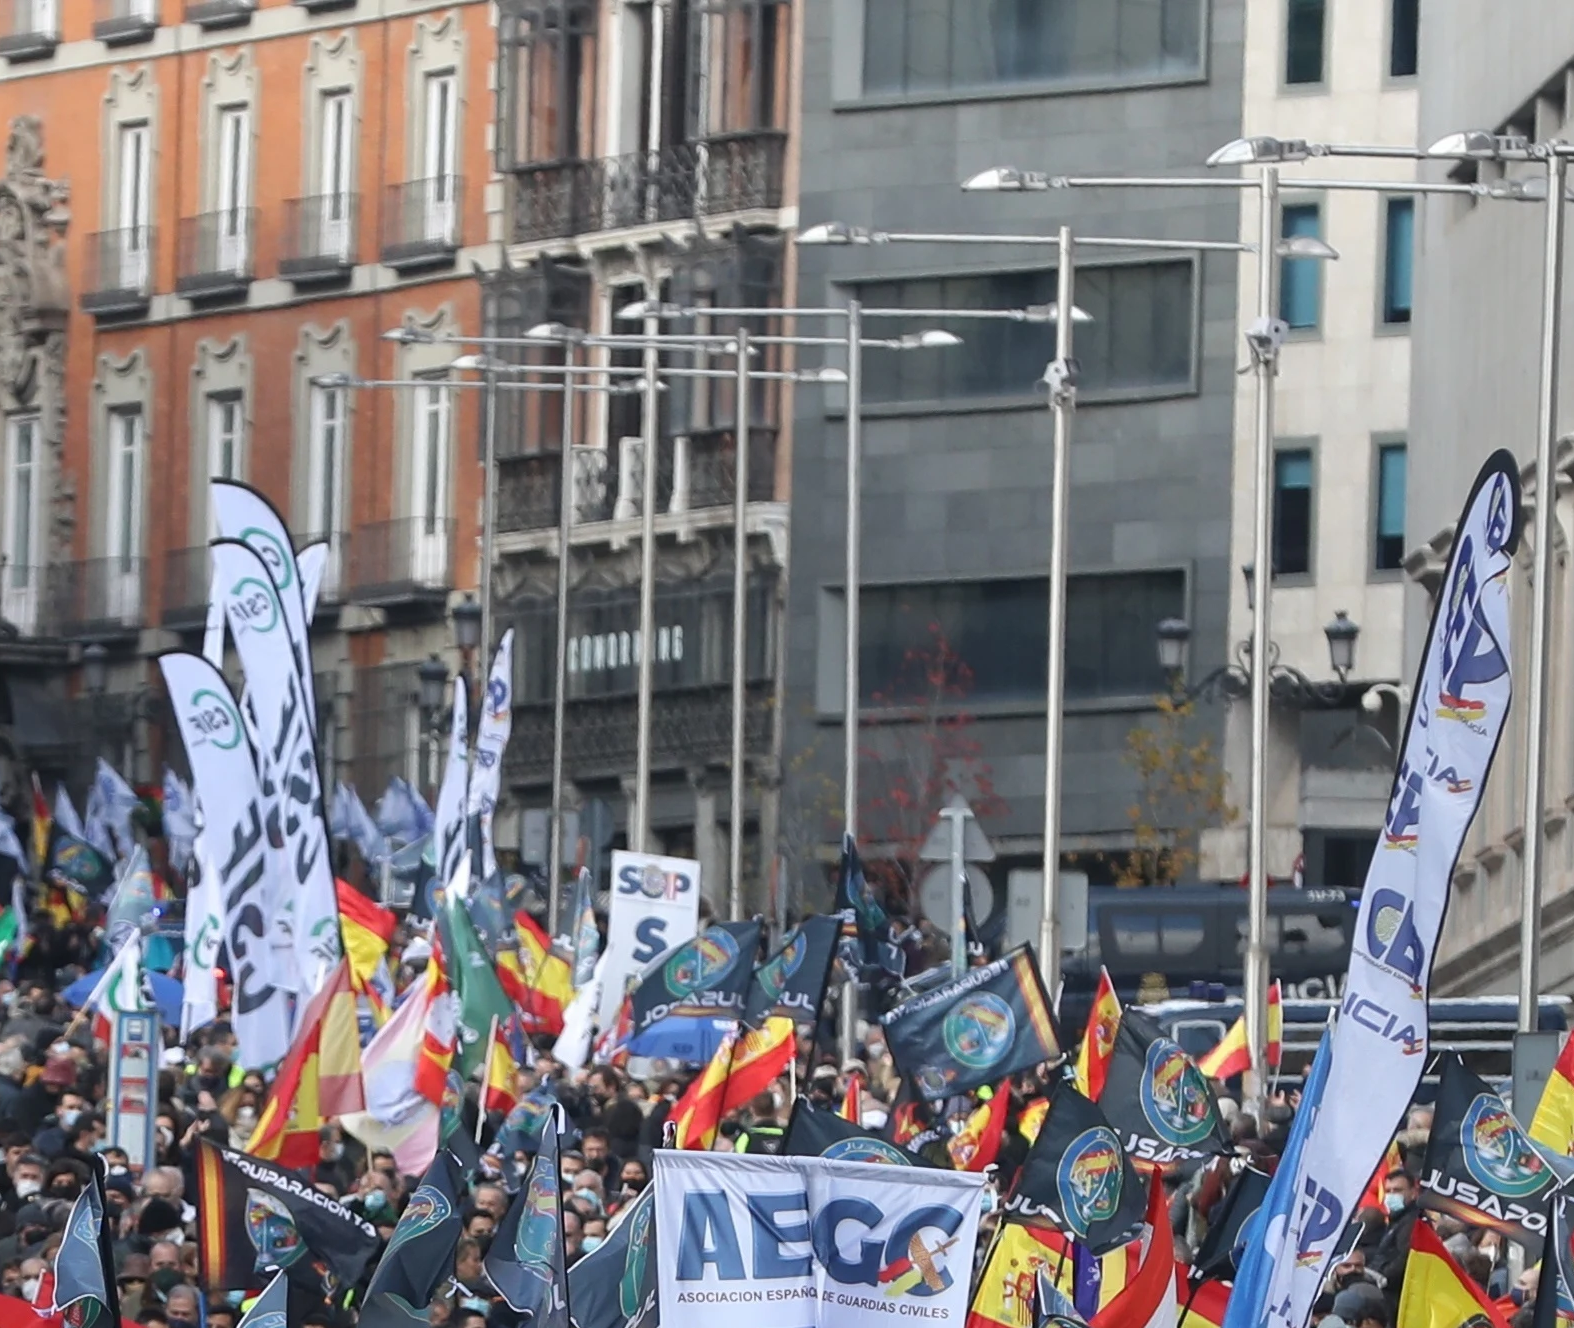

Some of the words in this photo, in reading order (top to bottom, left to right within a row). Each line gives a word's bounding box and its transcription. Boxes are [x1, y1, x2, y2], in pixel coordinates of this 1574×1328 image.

[675, 1189, 965, 1298] AEGC
[677, 1290, 762, 1304] ASOCIACION
[837, 1294, 896, 1314] GUARDIAS
[899, 1304, 950, 1320] CIVILES
